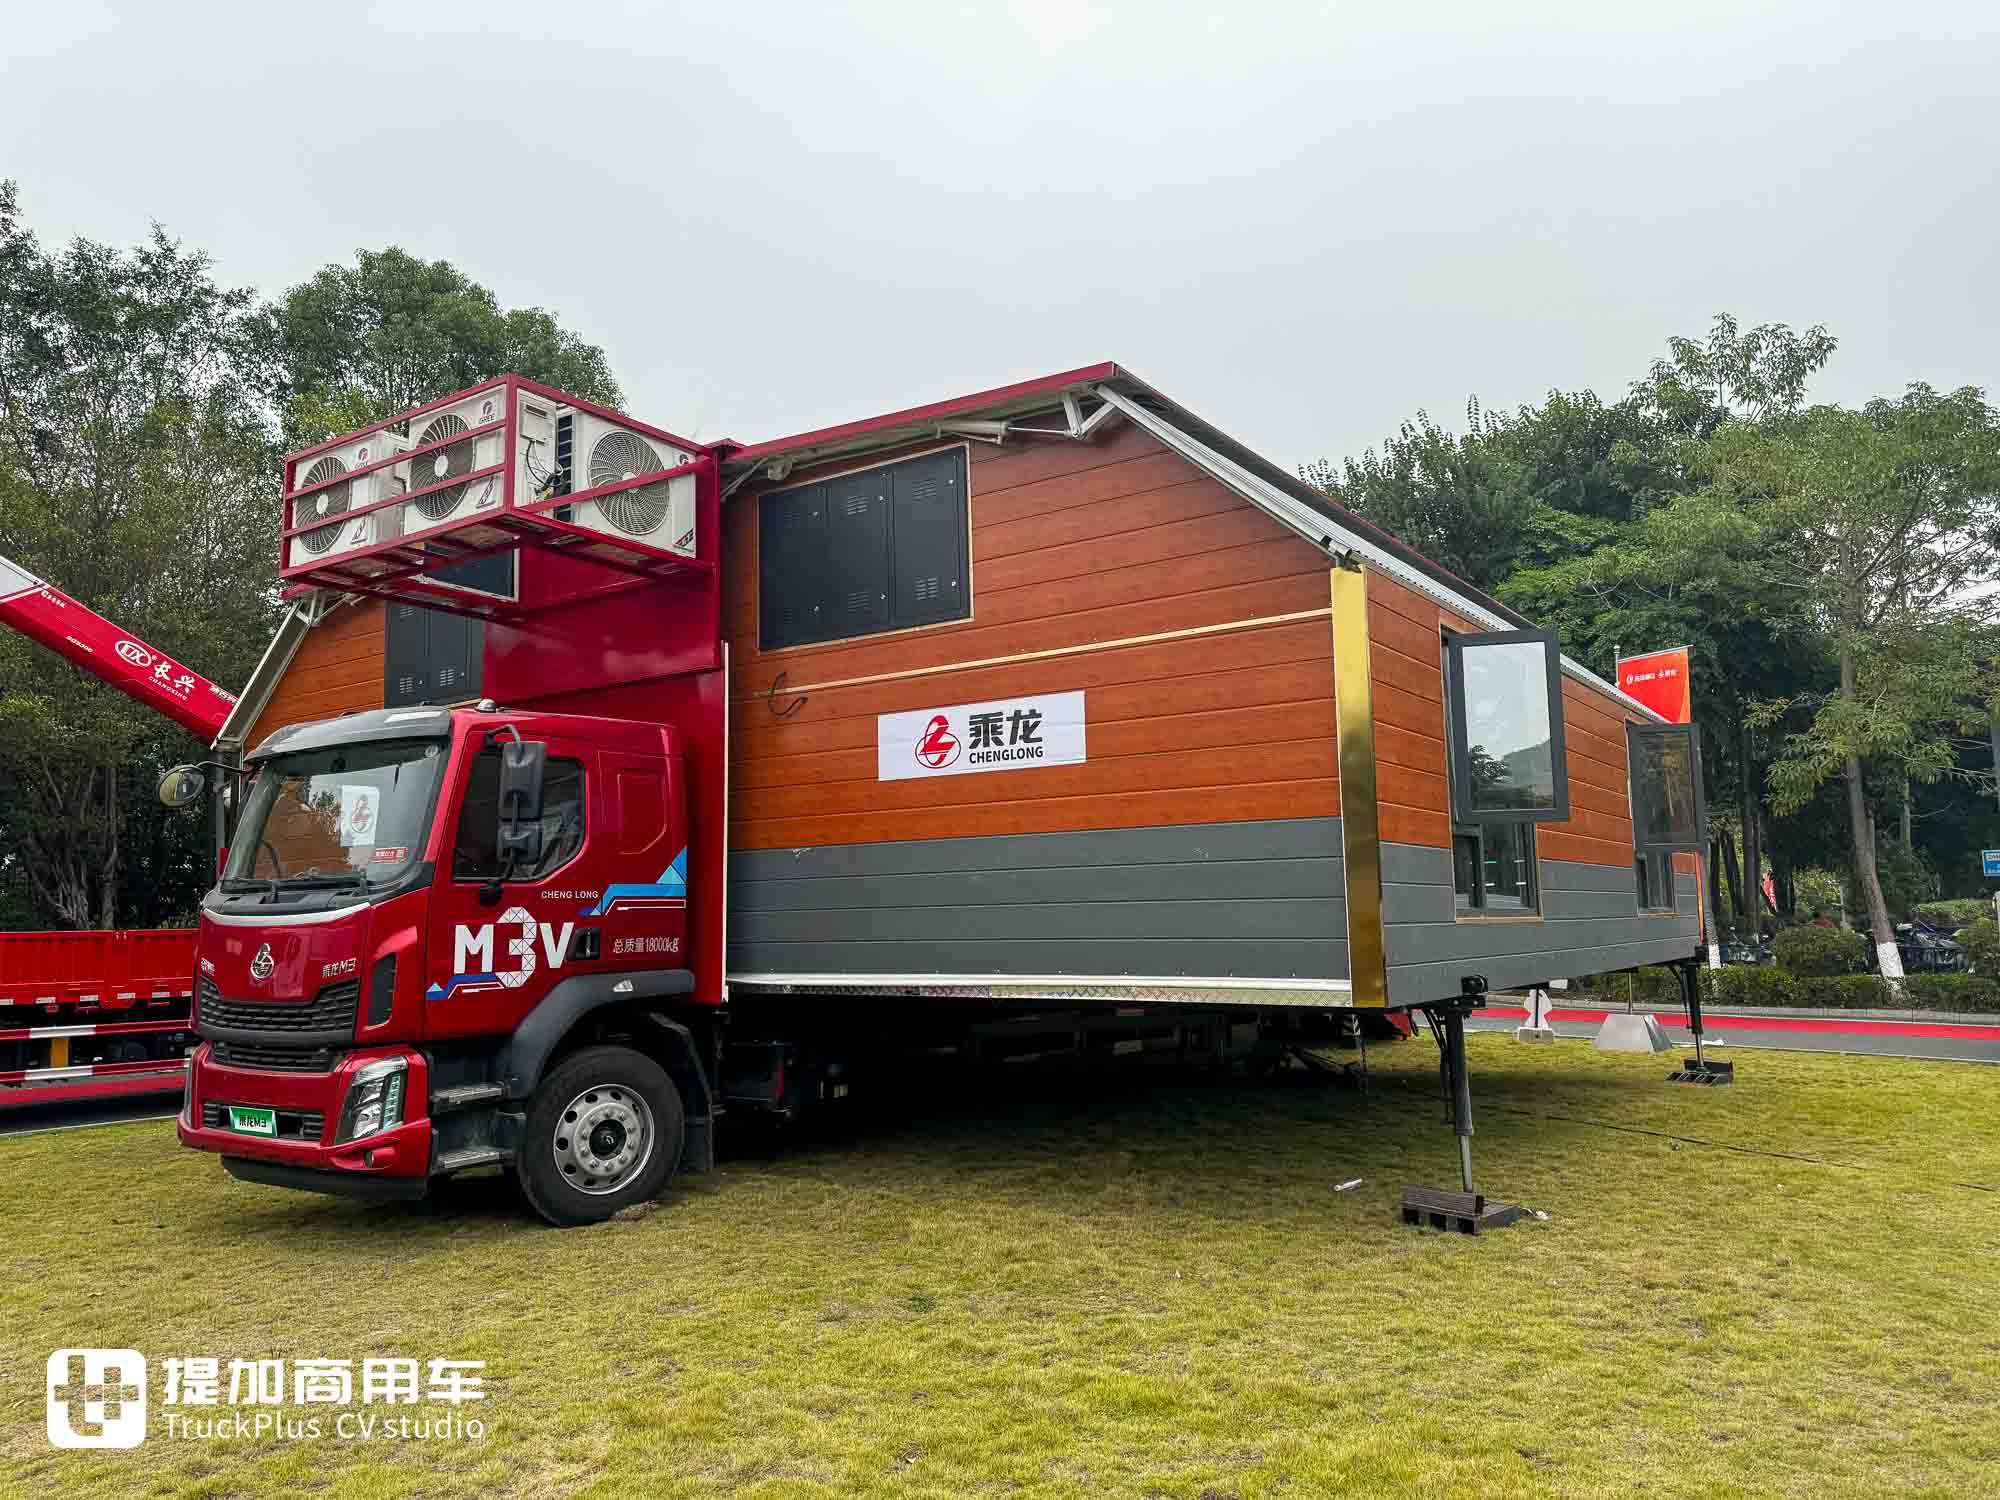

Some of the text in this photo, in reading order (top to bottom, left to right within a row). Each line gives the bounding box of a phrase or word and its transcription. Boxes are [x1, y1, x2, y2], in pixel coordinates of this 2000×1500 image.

[148, 675, 188, 701] CHANGXING
[154, 661, 195, 693] 长兴
[968, 709, 1043, 749] 乘龙
[969, 746, 1044, 764] CHENGLONG
[541, 890, 599, 900] CHENG LONG
[453, 906, 575, 988] M3V
[612, 937, 680, 954] 总质量18000kg
